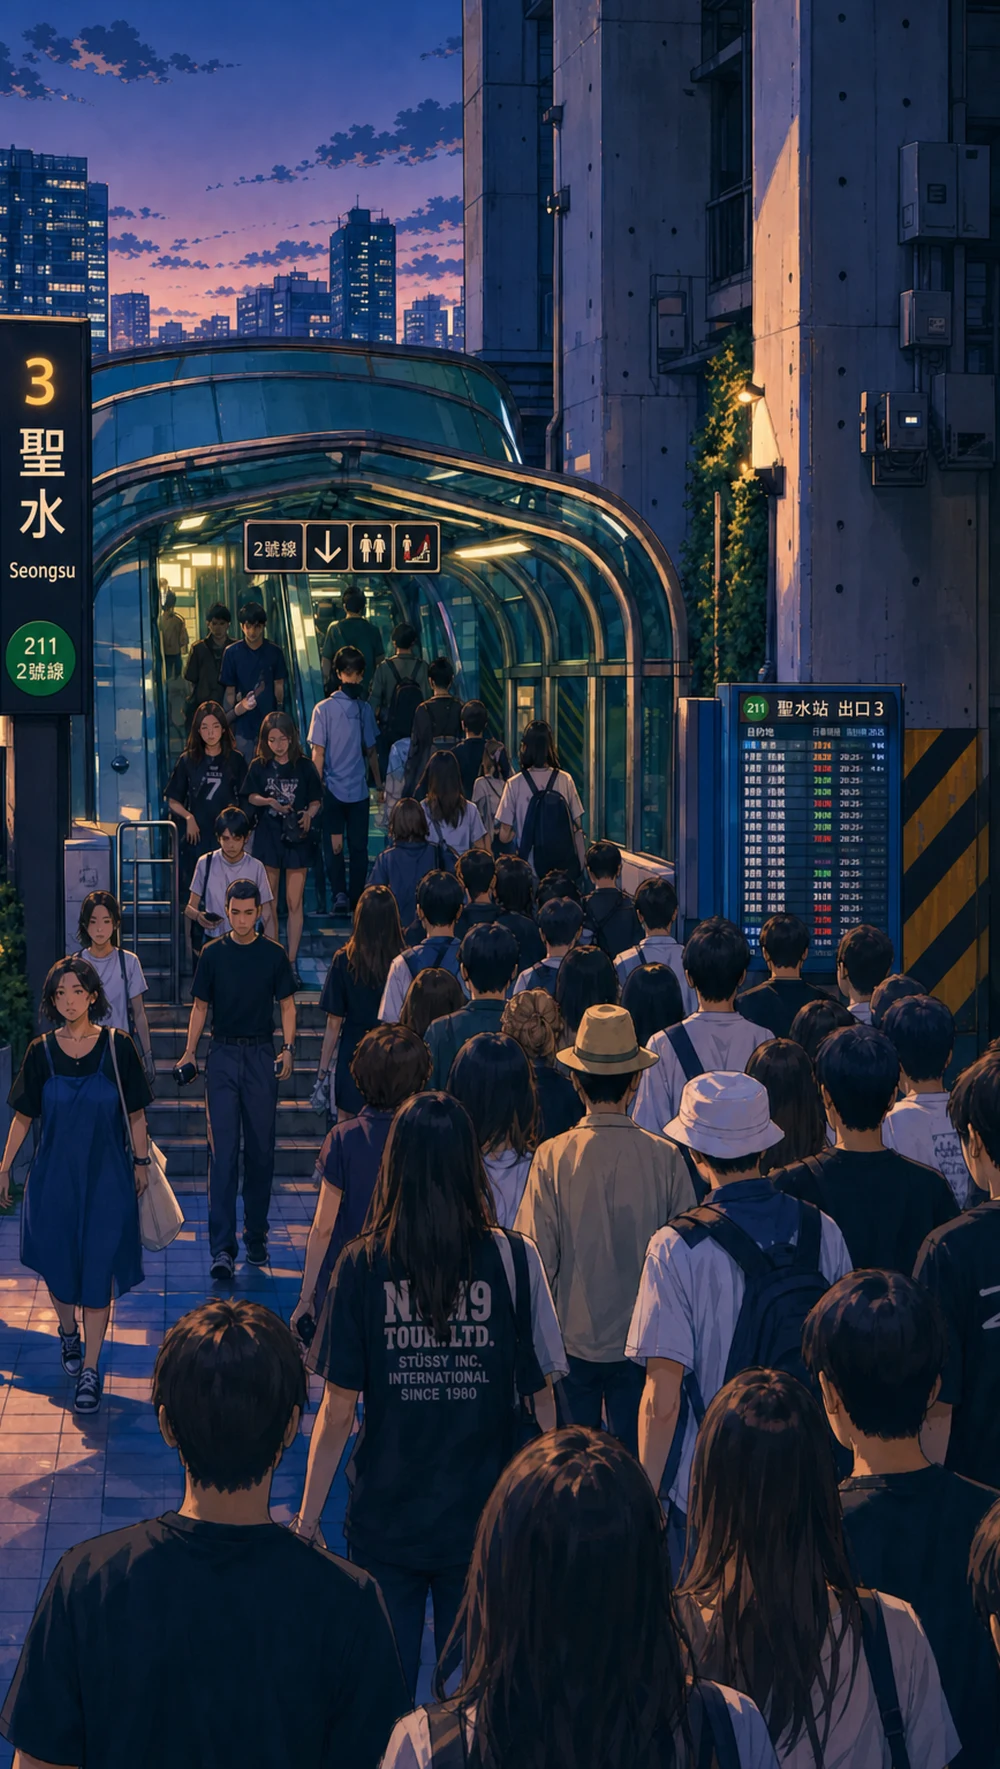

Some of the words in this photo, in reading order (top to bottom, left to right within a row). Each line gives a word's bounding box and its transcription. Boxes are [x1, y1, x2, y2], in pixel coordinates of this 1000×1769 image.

[25, 357, 55, 406] 3
[20, 428, 65, 539] 聖水
[253, 540, 297, 558] 2號線
[9, 561, 76, 583] Seongsu
[24, 637, 56, 655] 211
[16, 662, 64, 681] 2號線
[747, 703, 765, 714] 211
[777, 700, 829, 717] 聖水站
[205, 778, 222, 800] 7
[398, 1353, 449, 1368] STÜSSY
[455, 1355, 482, 1368] INC.
[388, 1371, 490, 1385] INTERNATIONAL
[401, 1388, 440, 1401] SINCE
[445, 1387, 477, 1400] 1980
